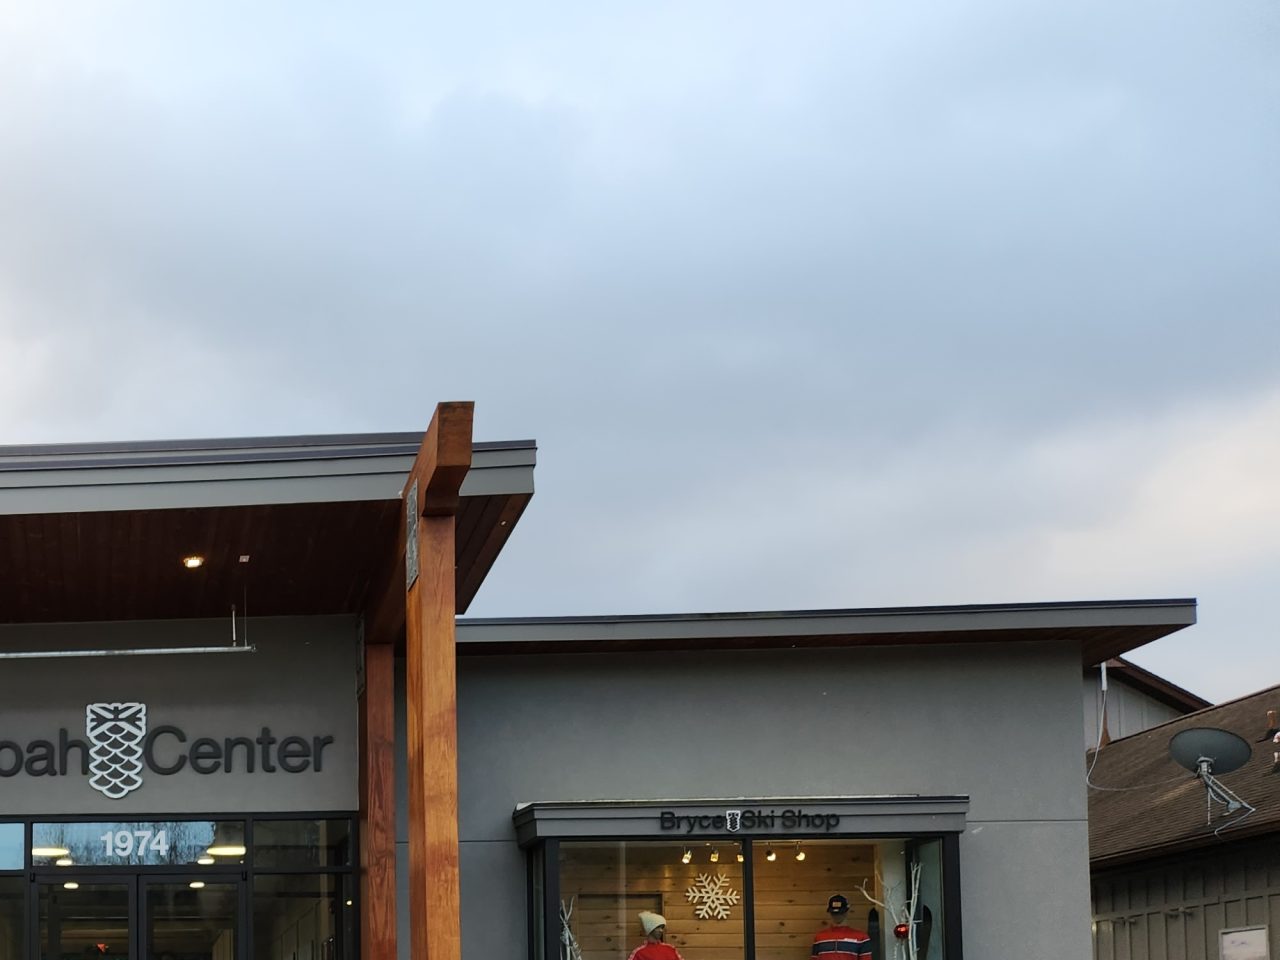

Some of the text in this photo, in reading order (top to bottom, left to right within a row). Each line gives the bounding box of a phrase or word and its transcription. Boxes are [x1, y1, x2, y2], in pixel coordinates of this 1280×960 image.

[142, 726, 334, 775] Center
[660, 809, 840, 833] Bryce Ski Shop
[100, 830, 169, 857] 1974
